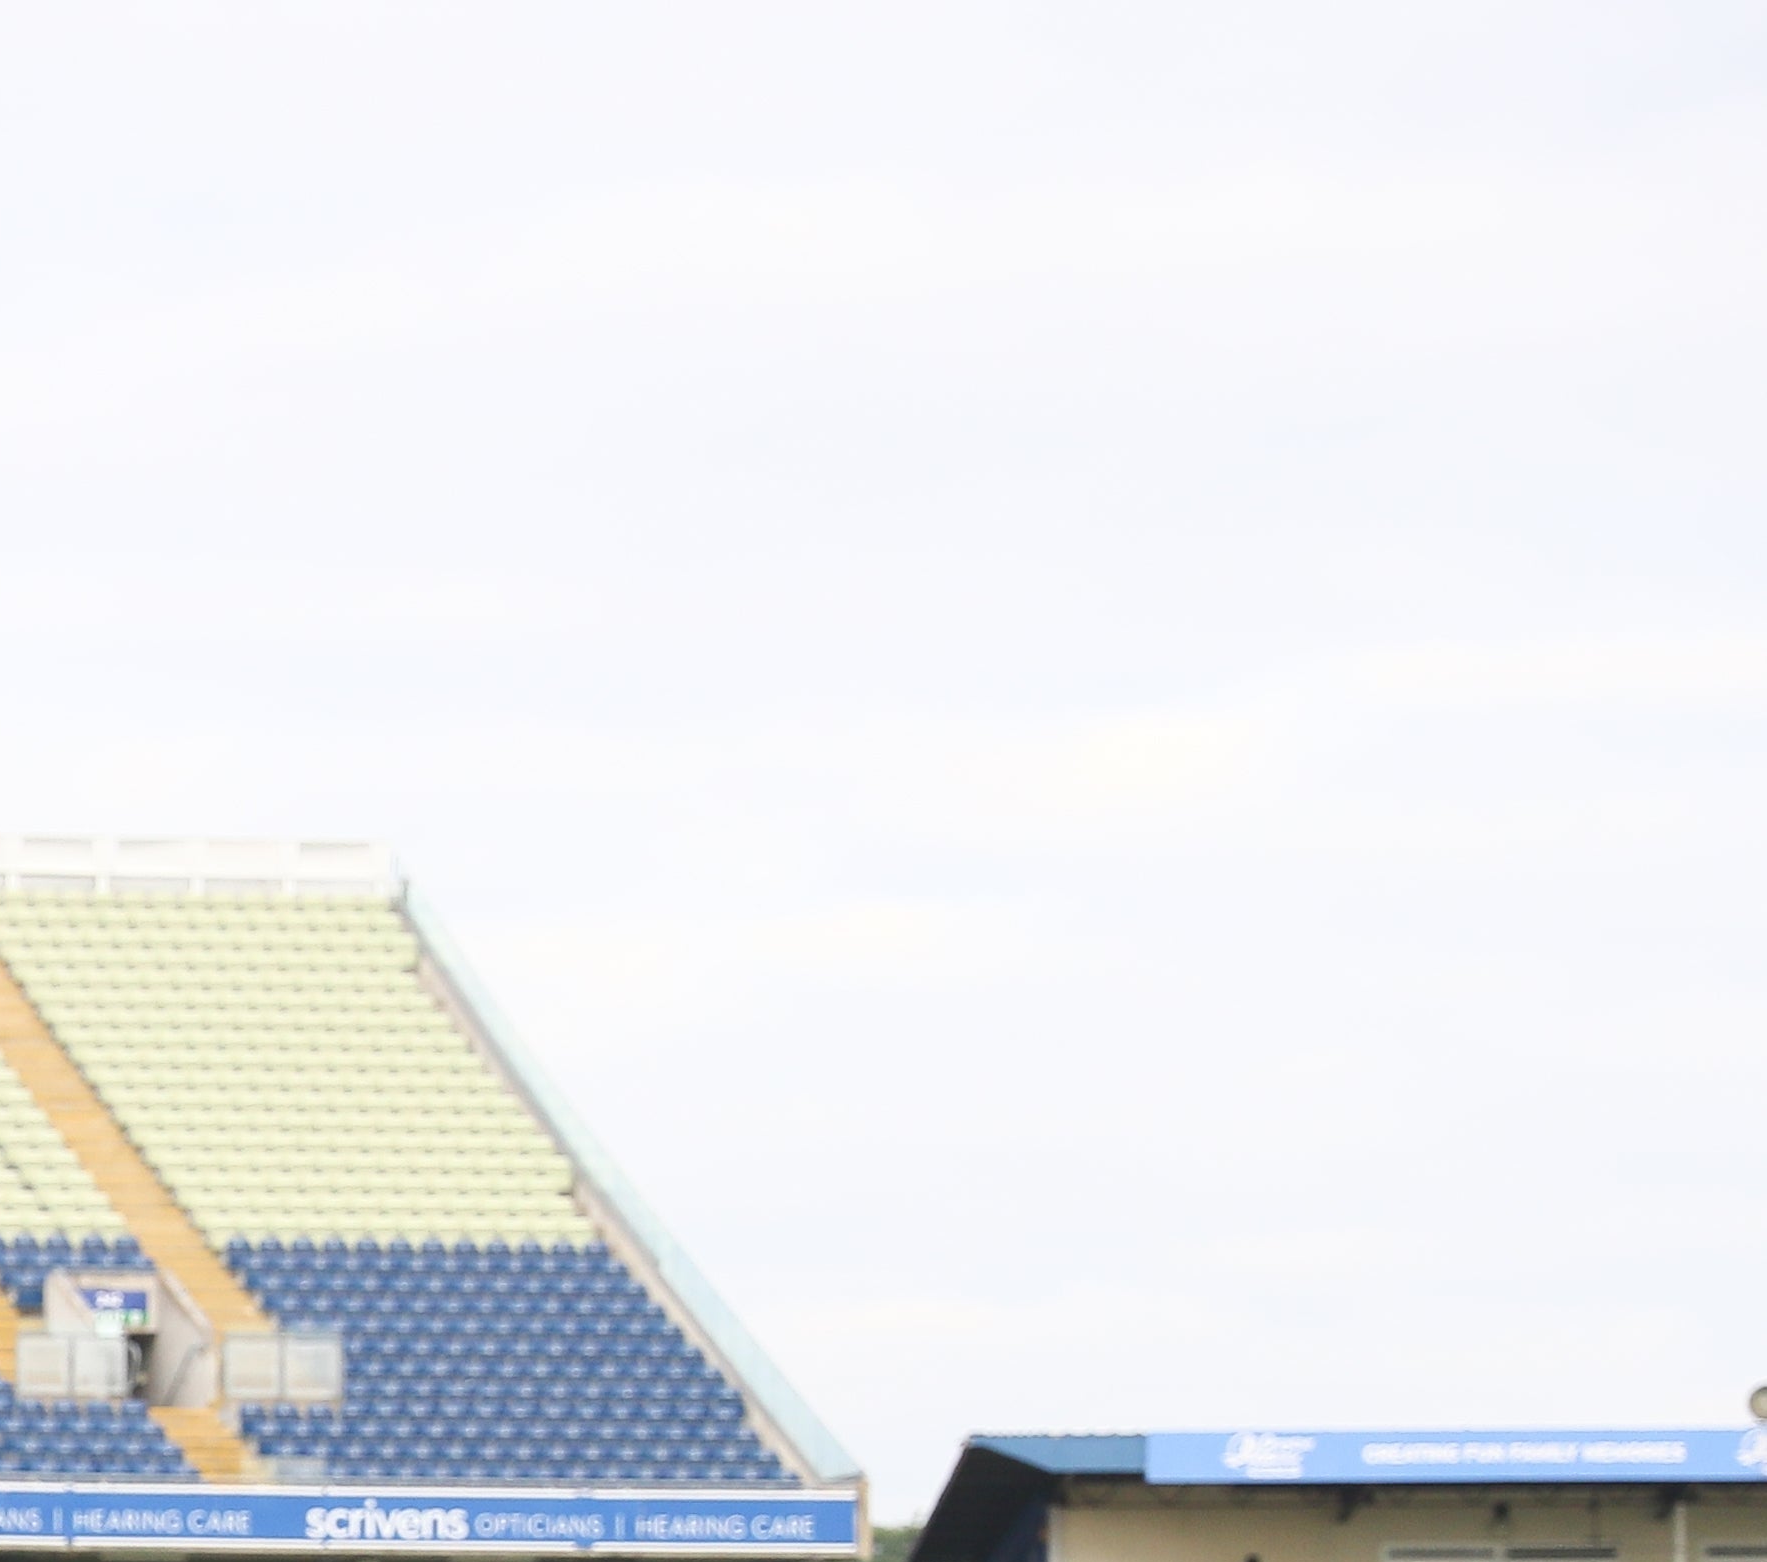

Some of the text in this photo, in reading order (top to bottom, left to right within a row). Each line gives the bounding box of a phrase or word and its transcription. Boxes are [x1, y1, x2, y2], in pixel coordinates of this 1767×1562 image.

[73, 1507, 183, 1534] HEARING
[187, 1508, 251, 1534] CARE
[305, 1498, 815, 1539] scrivens OPTICIANS HEARING CARE
